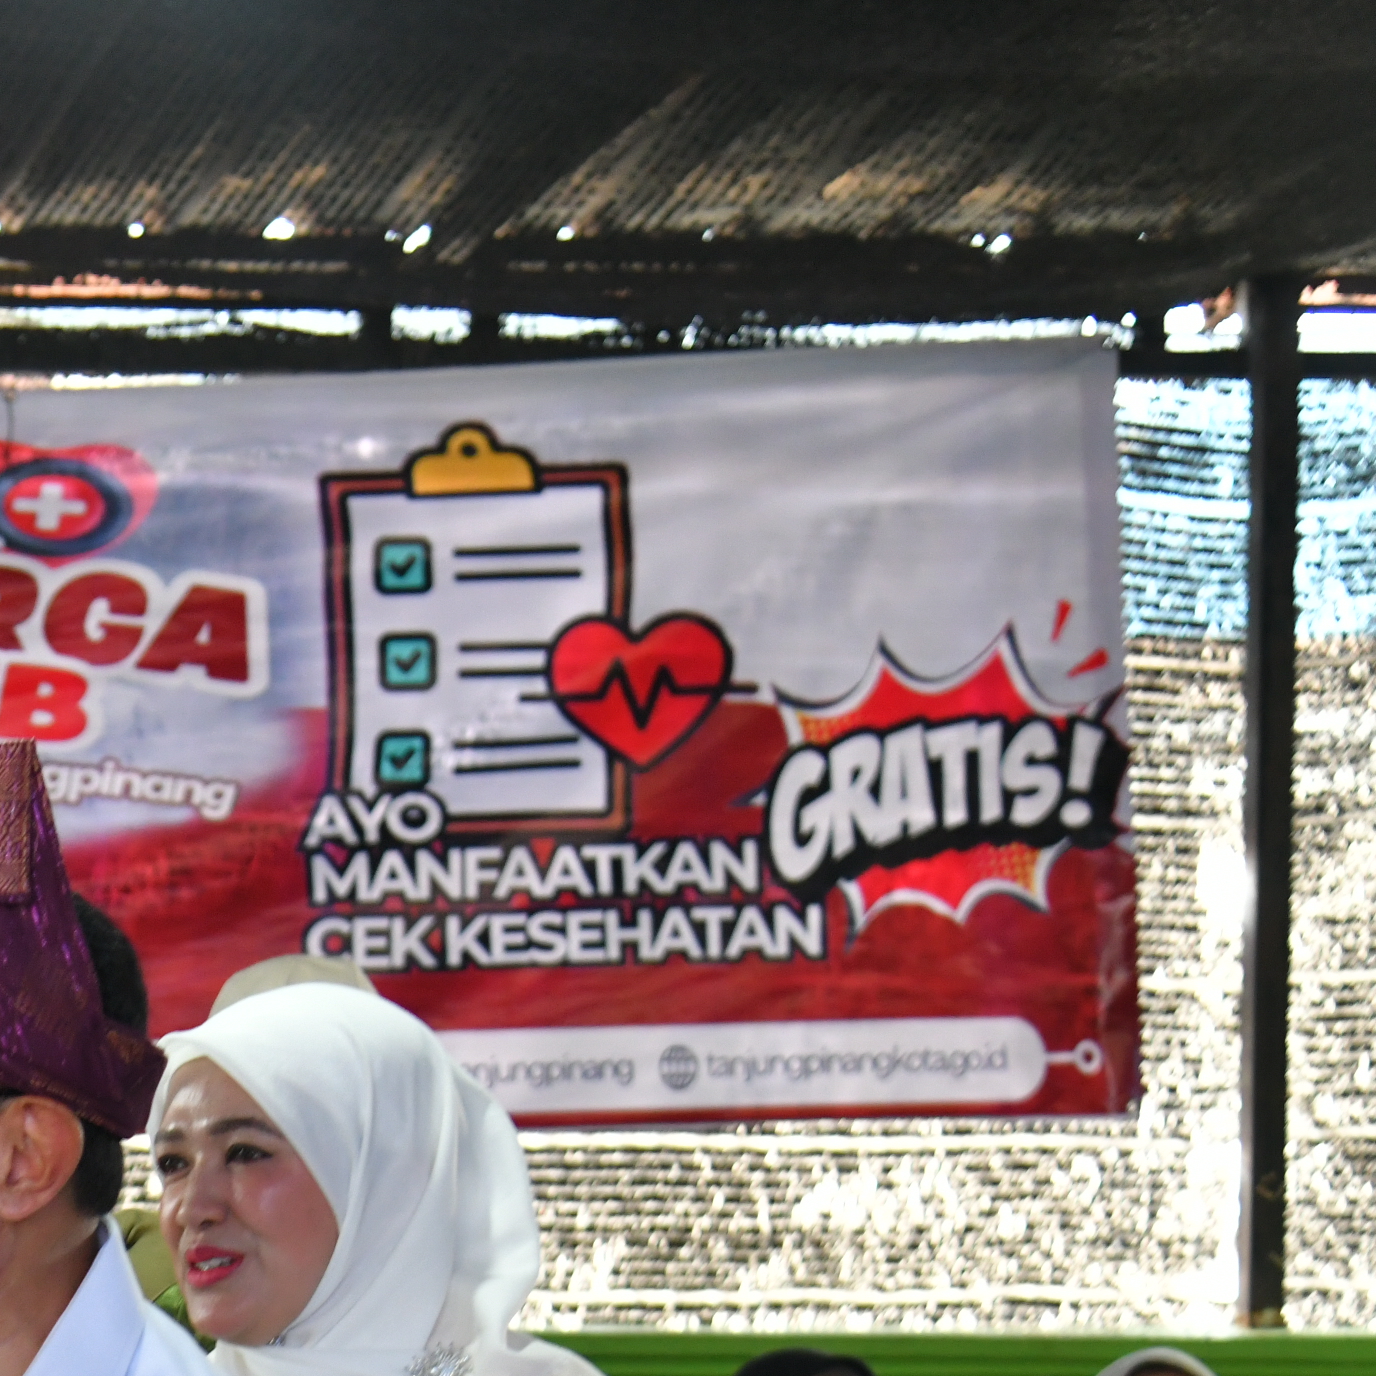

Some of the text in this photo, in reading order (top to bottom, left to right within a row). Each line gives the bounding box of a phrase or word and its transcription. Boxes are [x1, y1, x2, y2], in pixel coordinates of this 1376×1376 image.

[305, 792, 447, 845] AYO
[769, 716, 1107, 885] GRATIS!
[311, 837, 762, 902] MANFAATKAN
[306, 903, 826, 968] CEK KESEHATAN
